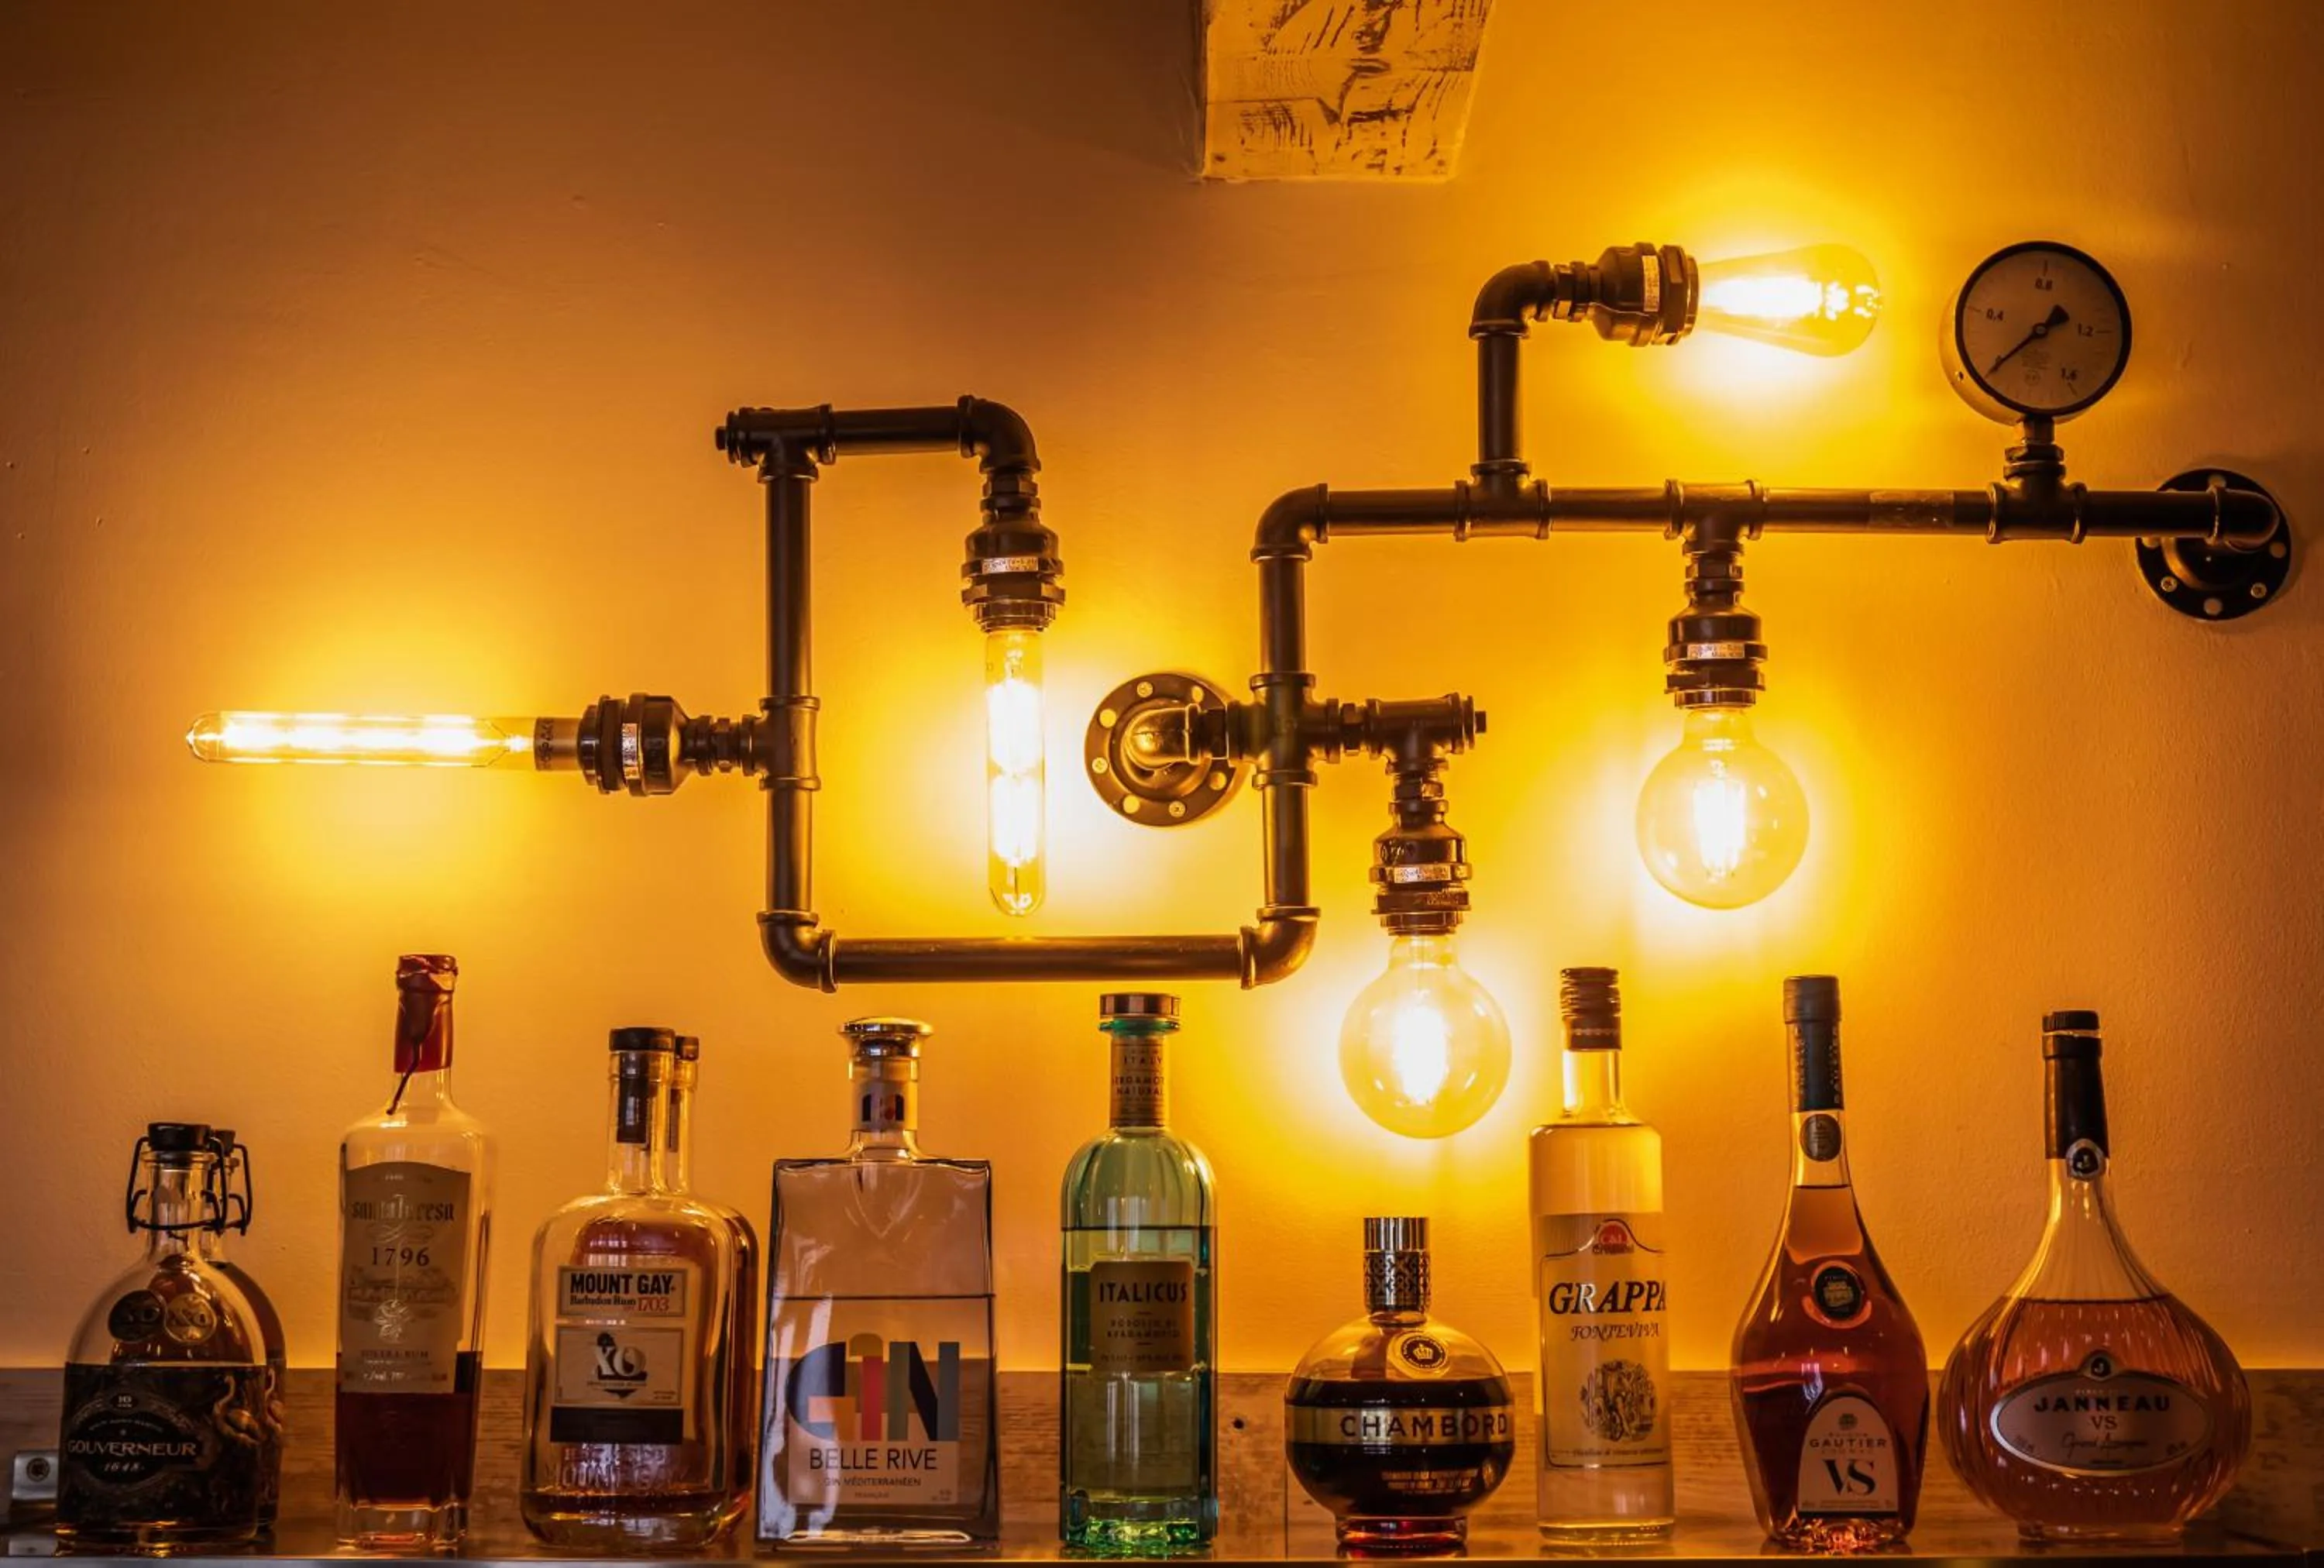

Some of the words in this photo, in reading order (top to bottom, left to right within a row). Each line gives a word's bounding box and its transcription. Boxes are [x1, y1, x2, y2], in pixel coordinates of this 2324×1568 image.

[371, 1246, 431, 1267] 1796
[570, 1273, 633, 1295] MOUNT
[637, 1274, 674, 1295] GAY
[1099, 1282, 1188, 1303] ITALICUS
[638, 1297, 670, 1312] 1703
[1570, 1321, 1660, 1344] FONTEVIVA
[594, 1345, 647, 1377] XO
[2093, 1361, 2104, 1374] J
[786, 1332, 960, 1442] GIN
[2033, 1396, 2170, 1412] JANNEAU
[1340, 1415, 1508, 1437] CHAMBORD
[2091, 1415, 2117, 1430] VS
[67, 1442, 197, 1456] GOUVERNEUR
[1809, 1439, 1887, 1448] GAUTIER
[810, 1448, 878, 1470] BELLE
[886, 1448, 938, 1470] RIVE
[1822, 1458, 1876, 1496] VS
